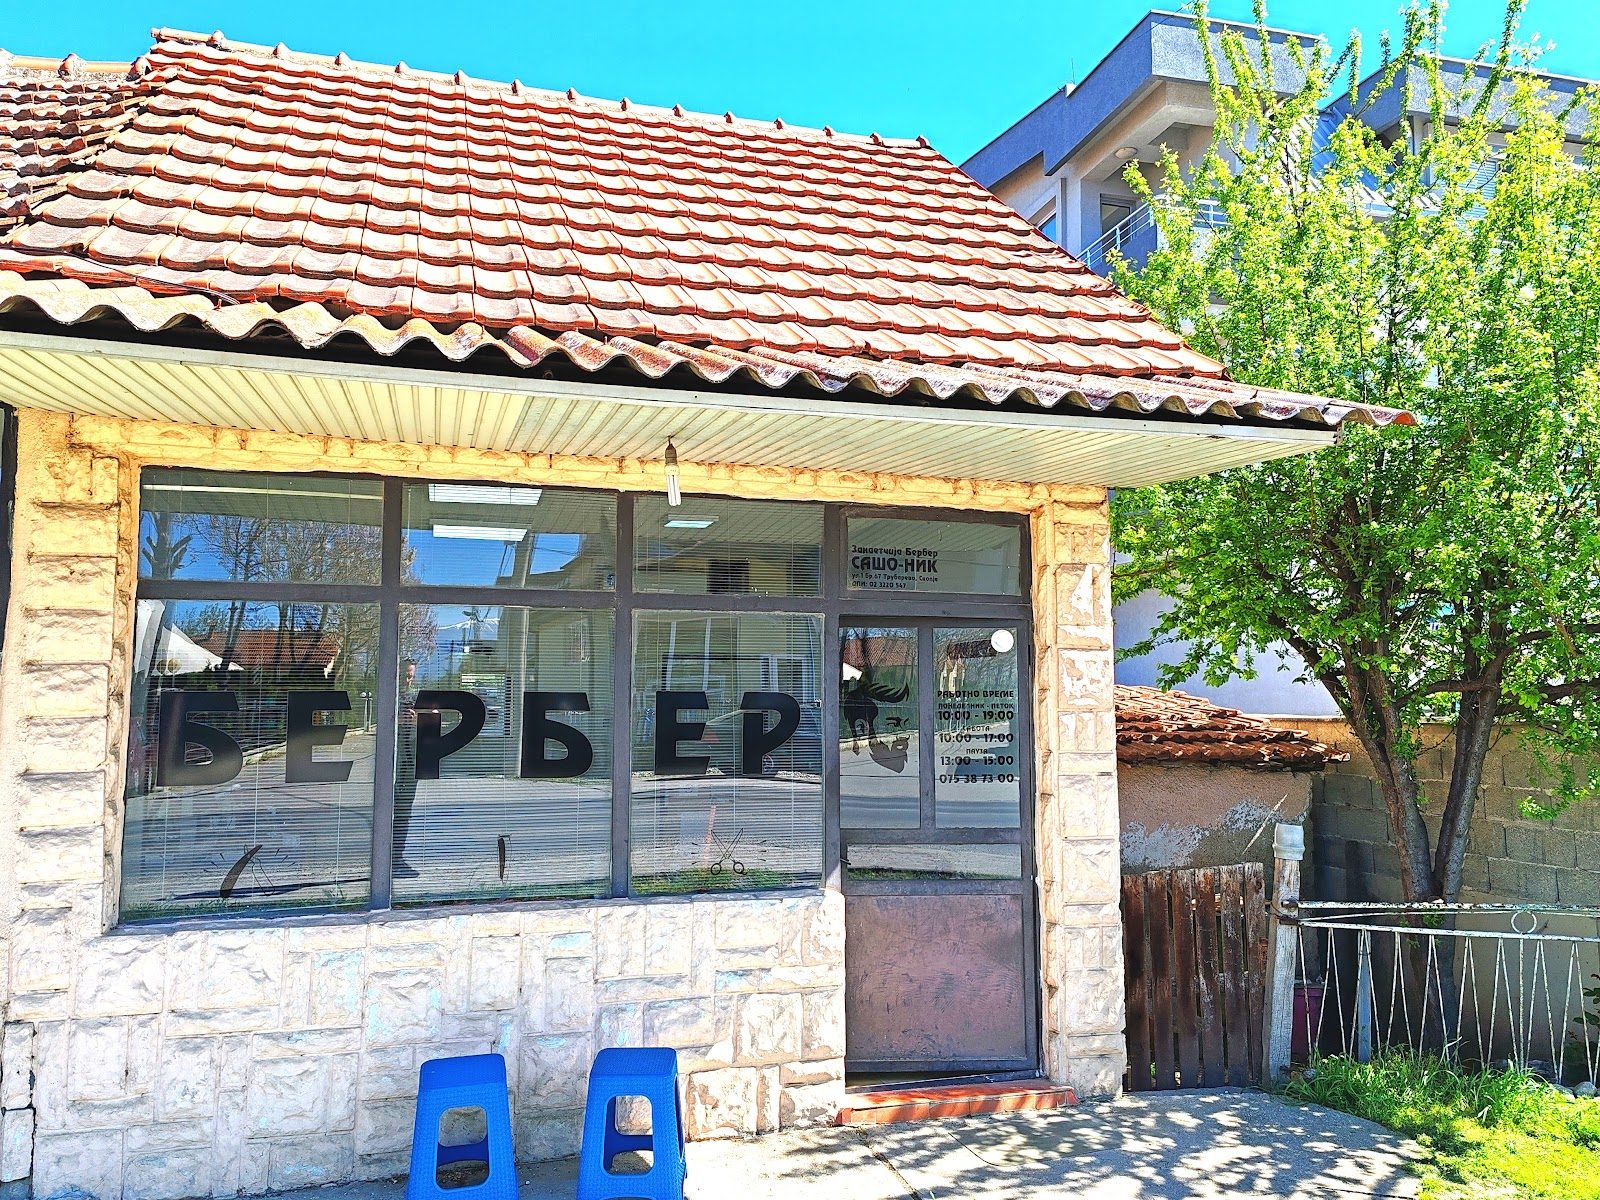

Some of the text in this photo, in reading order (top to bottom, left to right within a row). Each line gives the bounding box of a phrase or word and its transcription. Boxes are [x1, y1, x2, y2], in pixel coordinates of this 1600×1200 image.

[905, 547, 938, 559] Бербер
[851, 556, 938, 573] САШО-НИК
[937, 690, 1014, 698] РАБОТНО ВРЕМЕ
[938, 710, 971, 720] 10:00
[982, 710, 1014, 720] 19:00
[156, 690, 801, 786] БЕРБЕР
[939, 733, 972, 743] 10:00
[983, 733, 1014, 743] 17:00
[940, 755, 971, 766] 13:00
[982, 755, 1014, 766] 15:00
[939, 773, 1014, 784] 075 38 73 00
